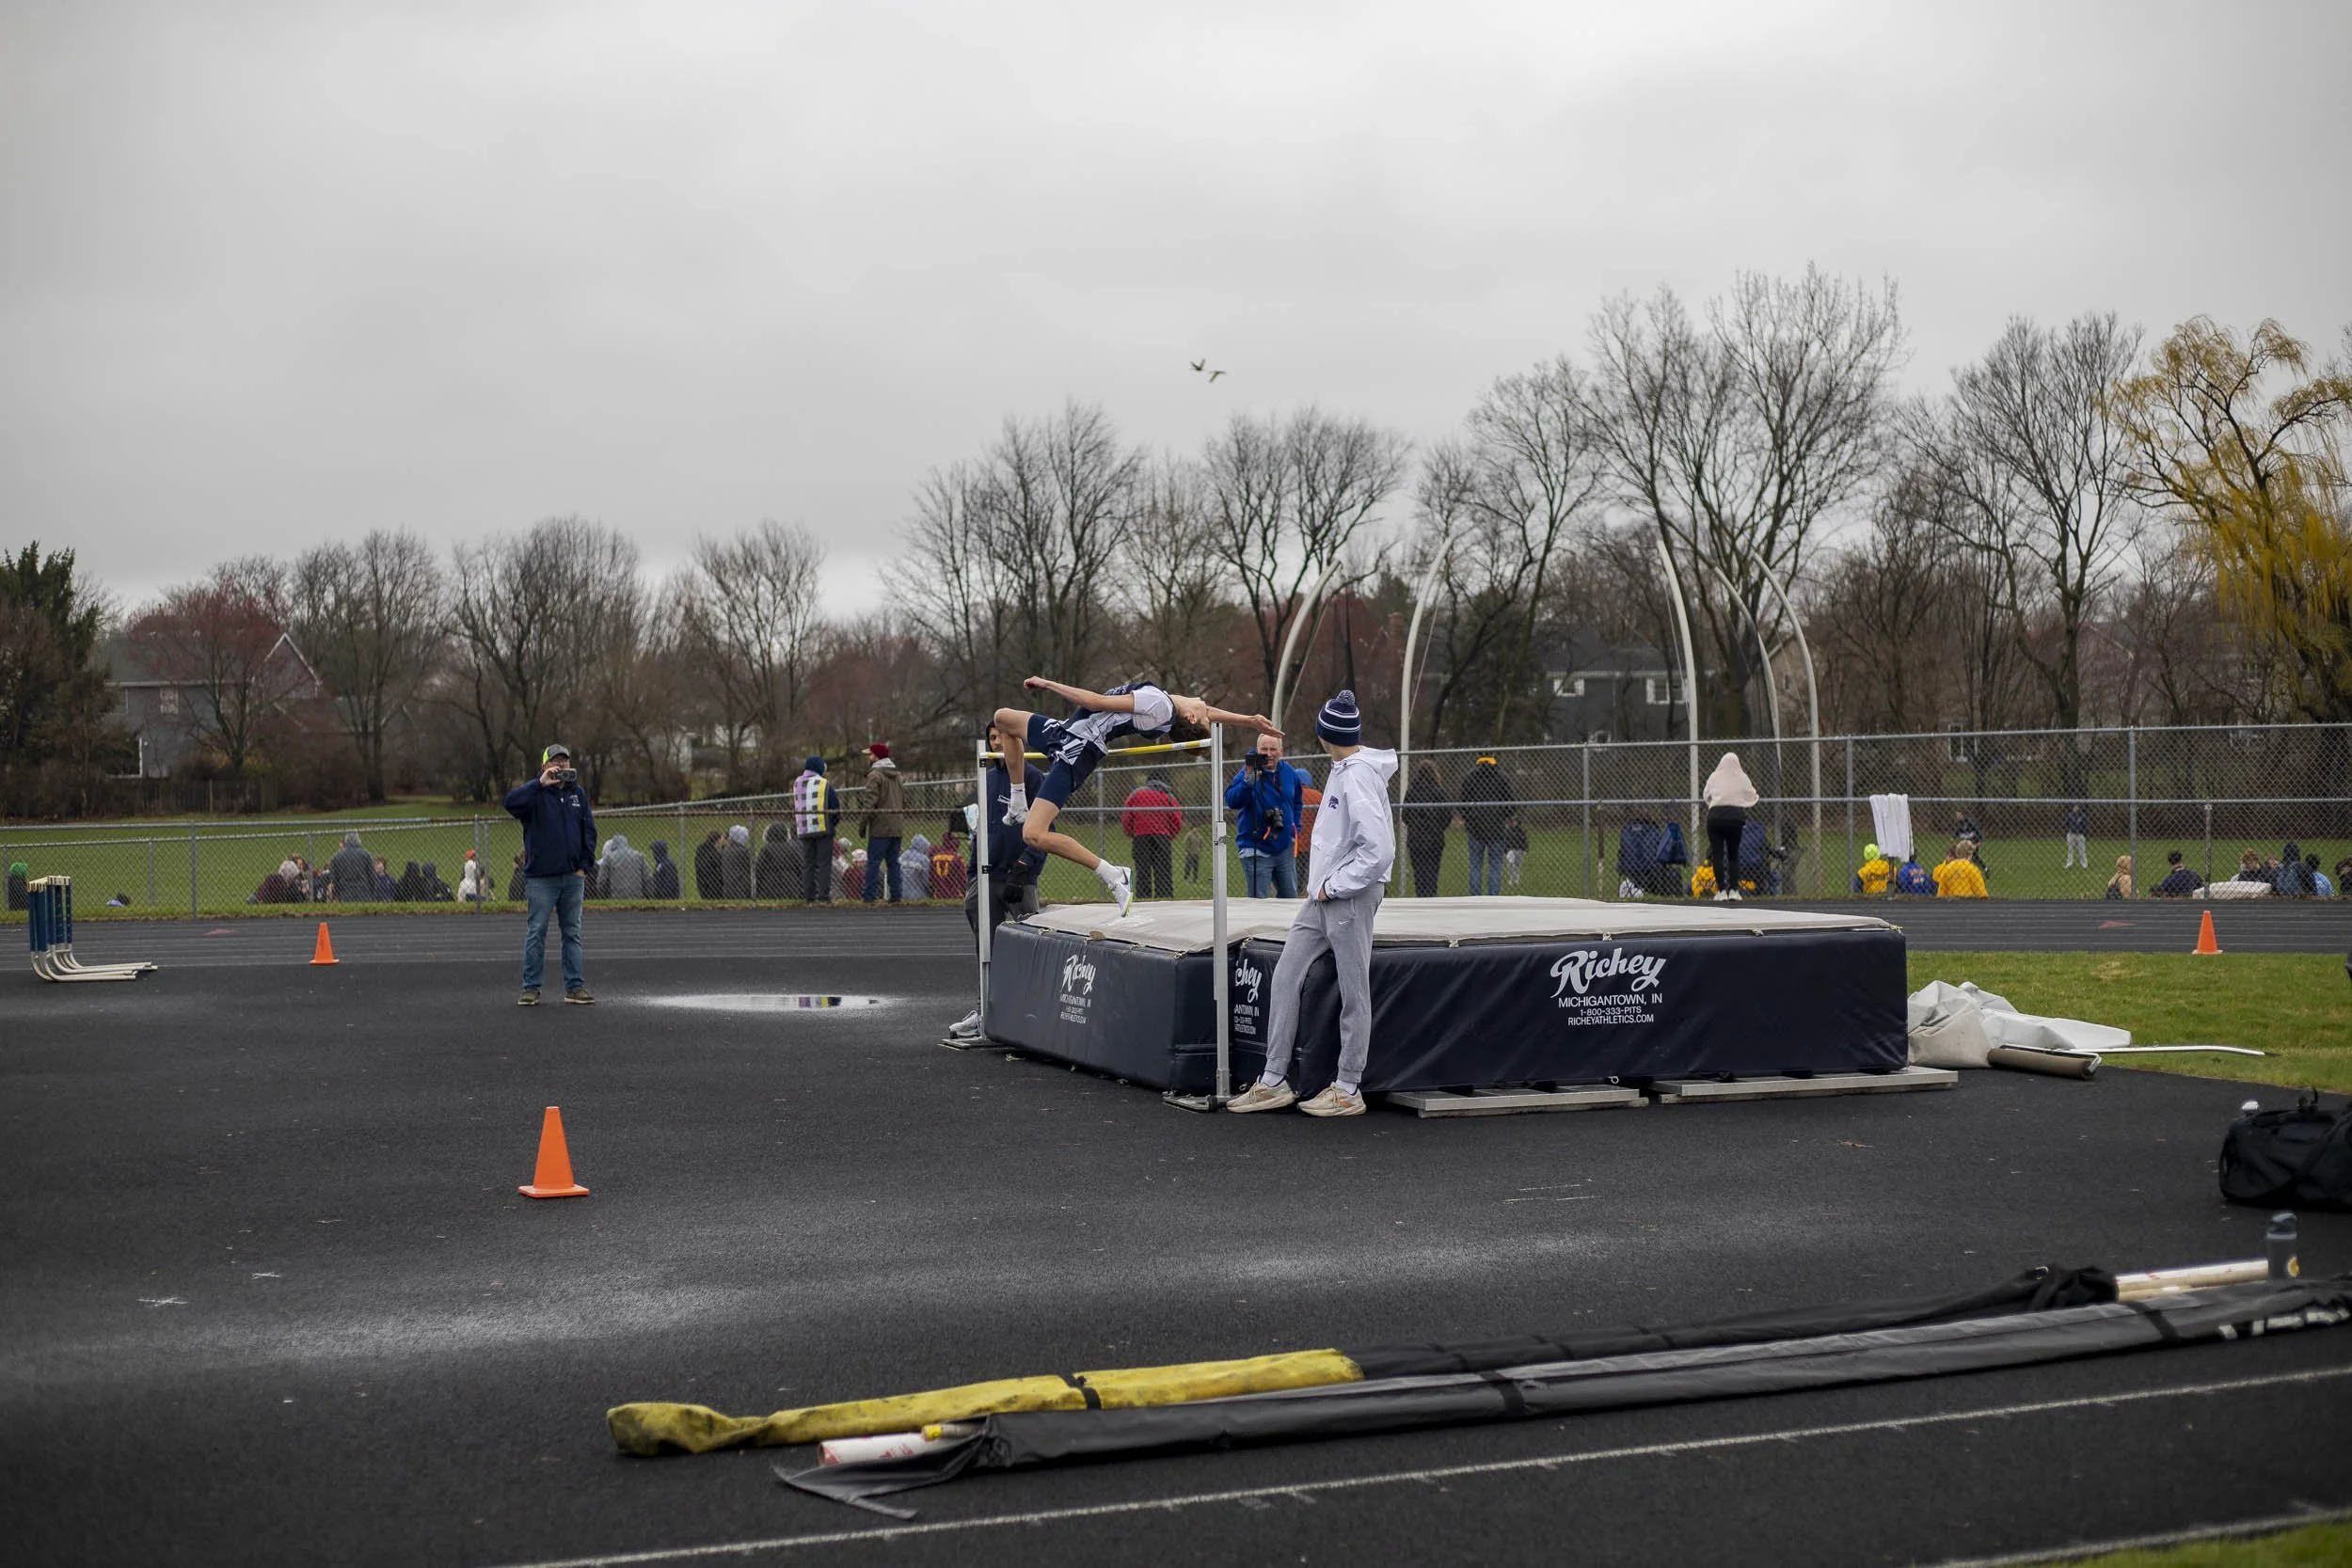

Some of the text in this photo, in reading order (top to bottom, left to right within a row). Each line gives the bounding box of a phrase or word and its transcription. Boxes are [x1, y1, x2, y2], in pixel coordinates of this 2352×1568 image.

[1060, 955, 1096, 995] Richey
[1235, 958, 1262, 1003] chey
[1549, 947, 1667, 999] Richey
[1558, 992, 1663, 1008] MICHIGANTOWN, IN
[1581, 1006, 1642, 1017] 1-800-333-PITS
[1568, 1014, 1654, 1026] RICHEYATHLETICS.COM
